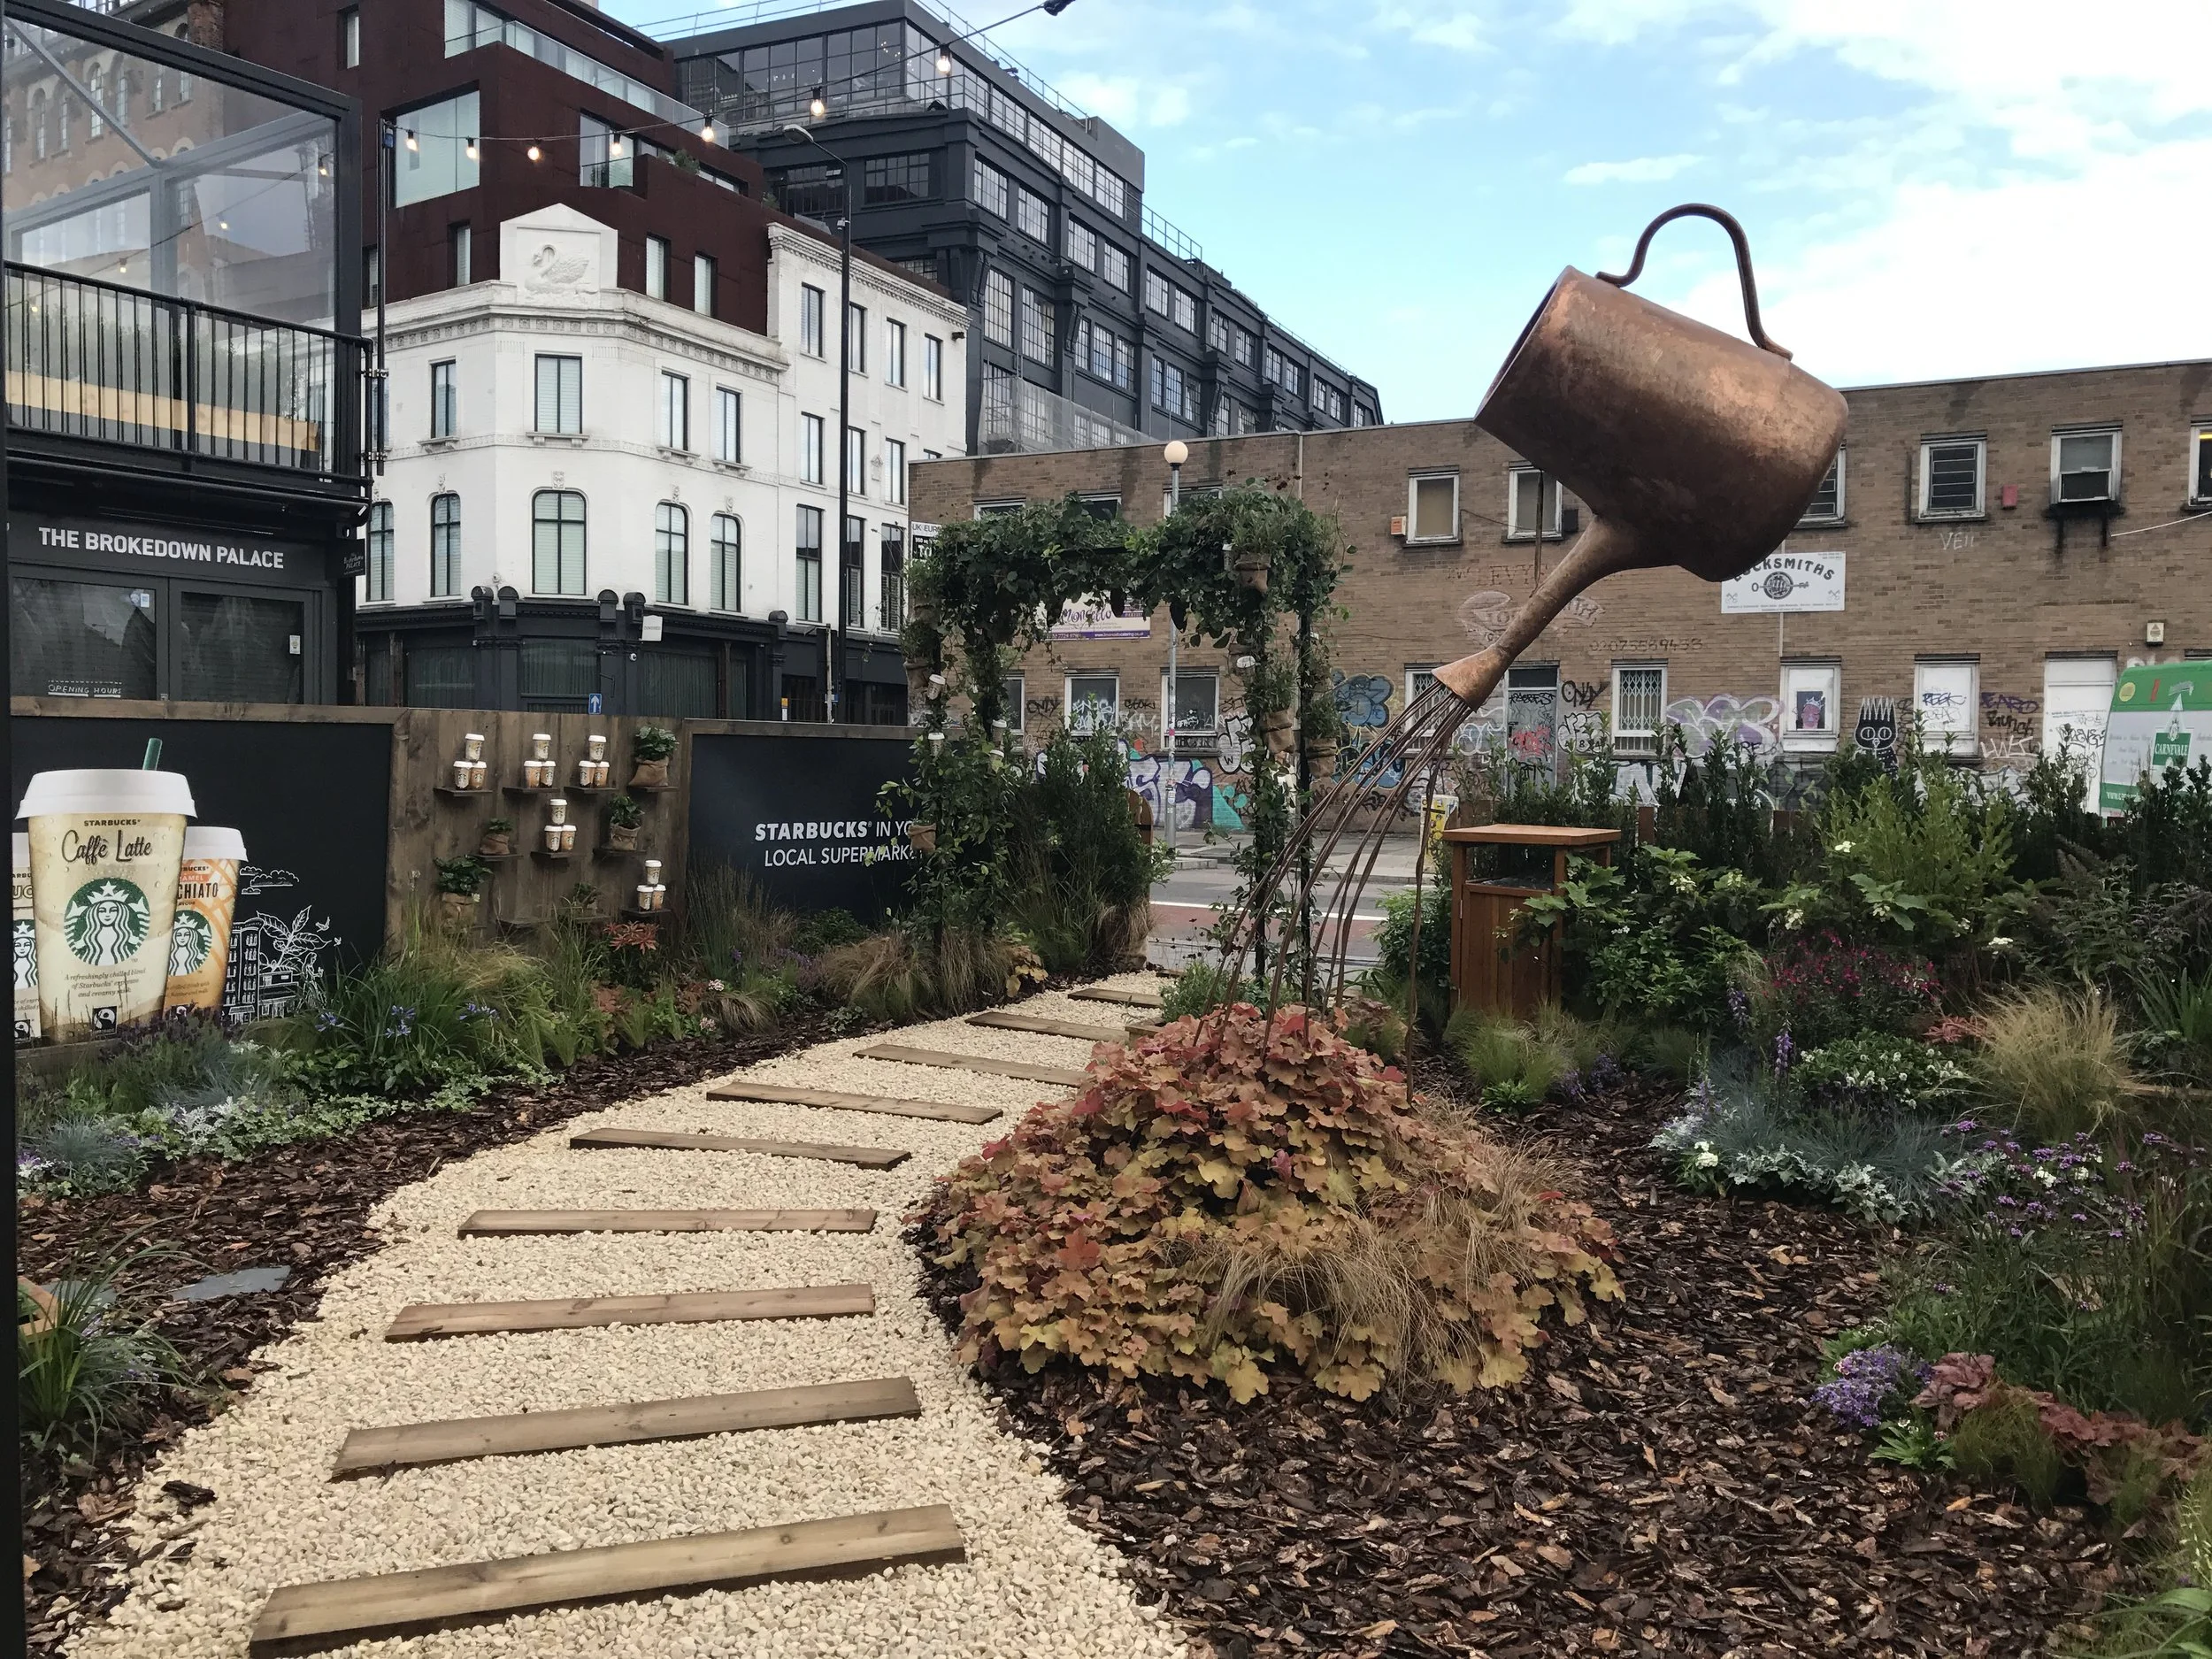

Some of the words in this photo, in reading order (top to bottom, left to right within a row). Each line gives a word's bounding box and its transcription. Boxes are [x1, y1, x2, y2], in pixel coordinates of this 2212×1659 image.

[39, 526, 79, 549] THE
[85, 532, 211, 562] BROKEDOWN
[216, 546, 284, 569] PALACE
[1734, 557, 1835, 581] KSMITHS
[49, 684, 89, 694] OPENING
[876, 821, 891, 837] IN
[61, 830, 109, 864] Caffè
[116, 830, 153, 863] Latte
[764, 849, 817, 867] LOCAL
[71, 972, 109, 981] refreshingly
